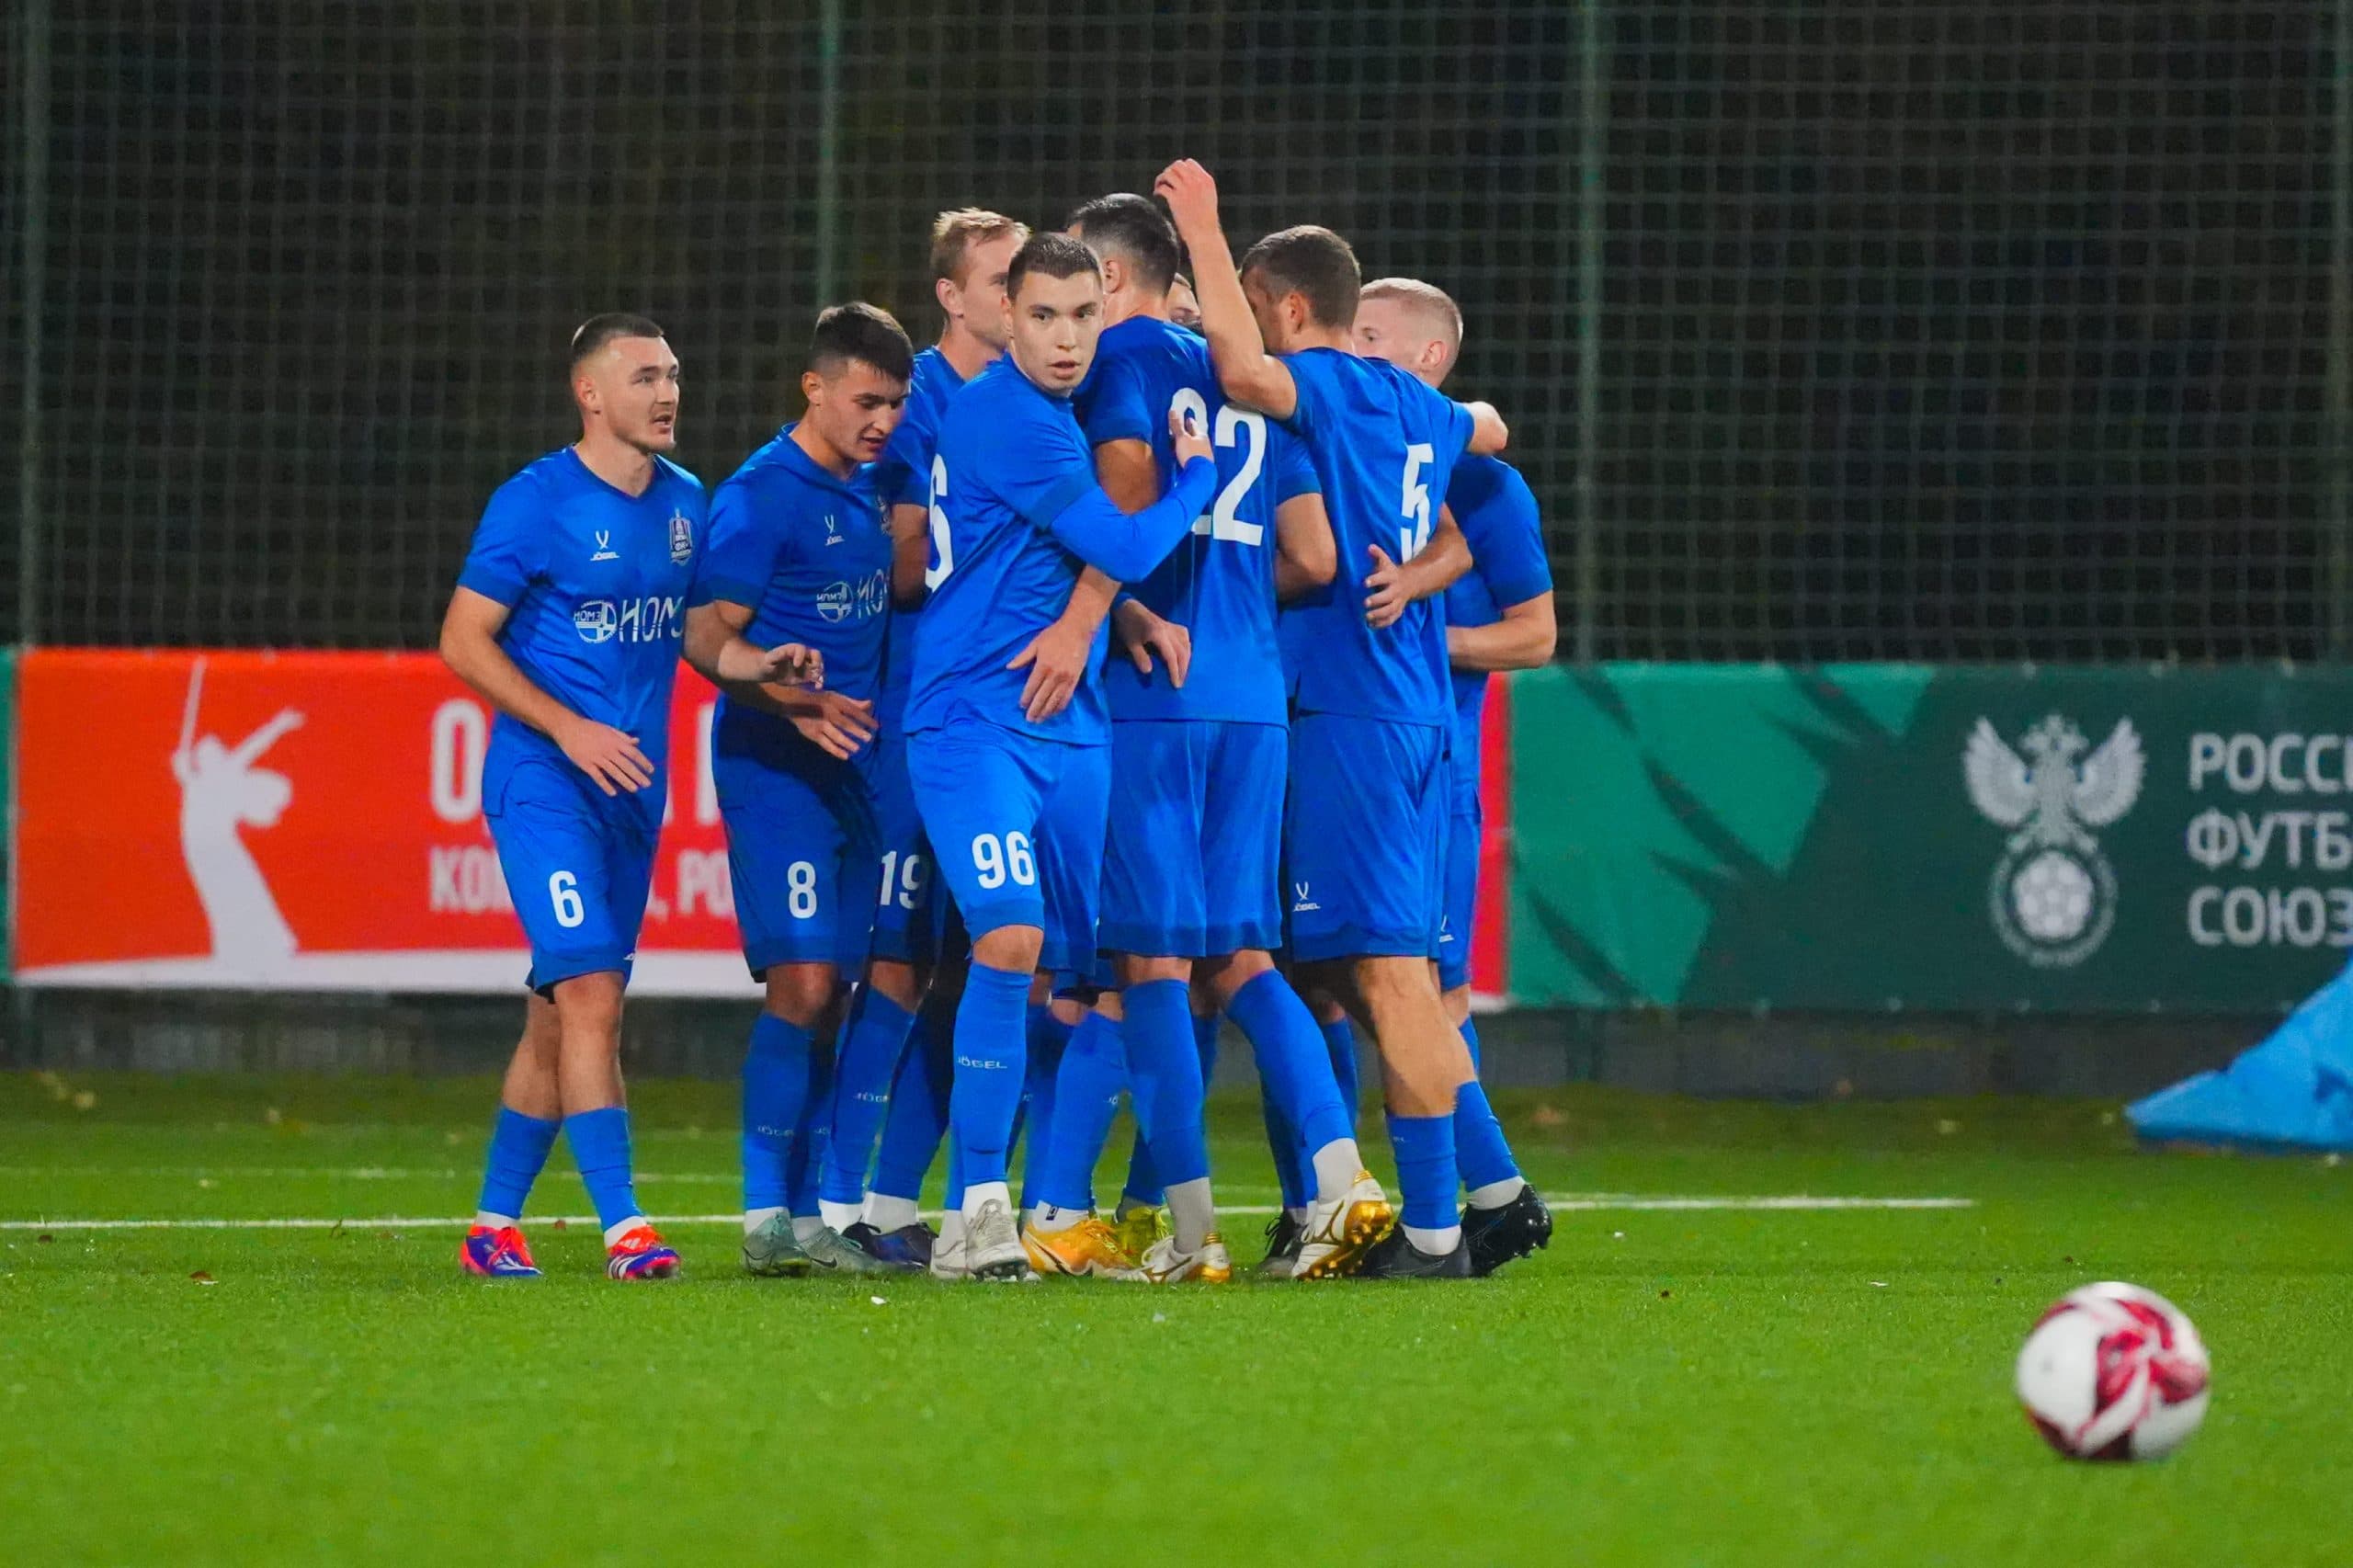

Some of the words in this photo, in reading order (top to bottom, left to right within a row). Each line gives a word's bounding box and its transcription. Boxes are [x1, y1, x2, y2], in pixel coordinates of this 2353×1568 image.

[1400, 443, 1434, 563] 5
[972, 831, 1035, 889] 96
[2187, 807, 2353, 871] ФУТБ
[549, 869, 585, 927] 6
[788, 861, 817, 918] 8
[880, 851, 926, 909] 19
[2188, 886, 2353, 948] СОЮЗ
